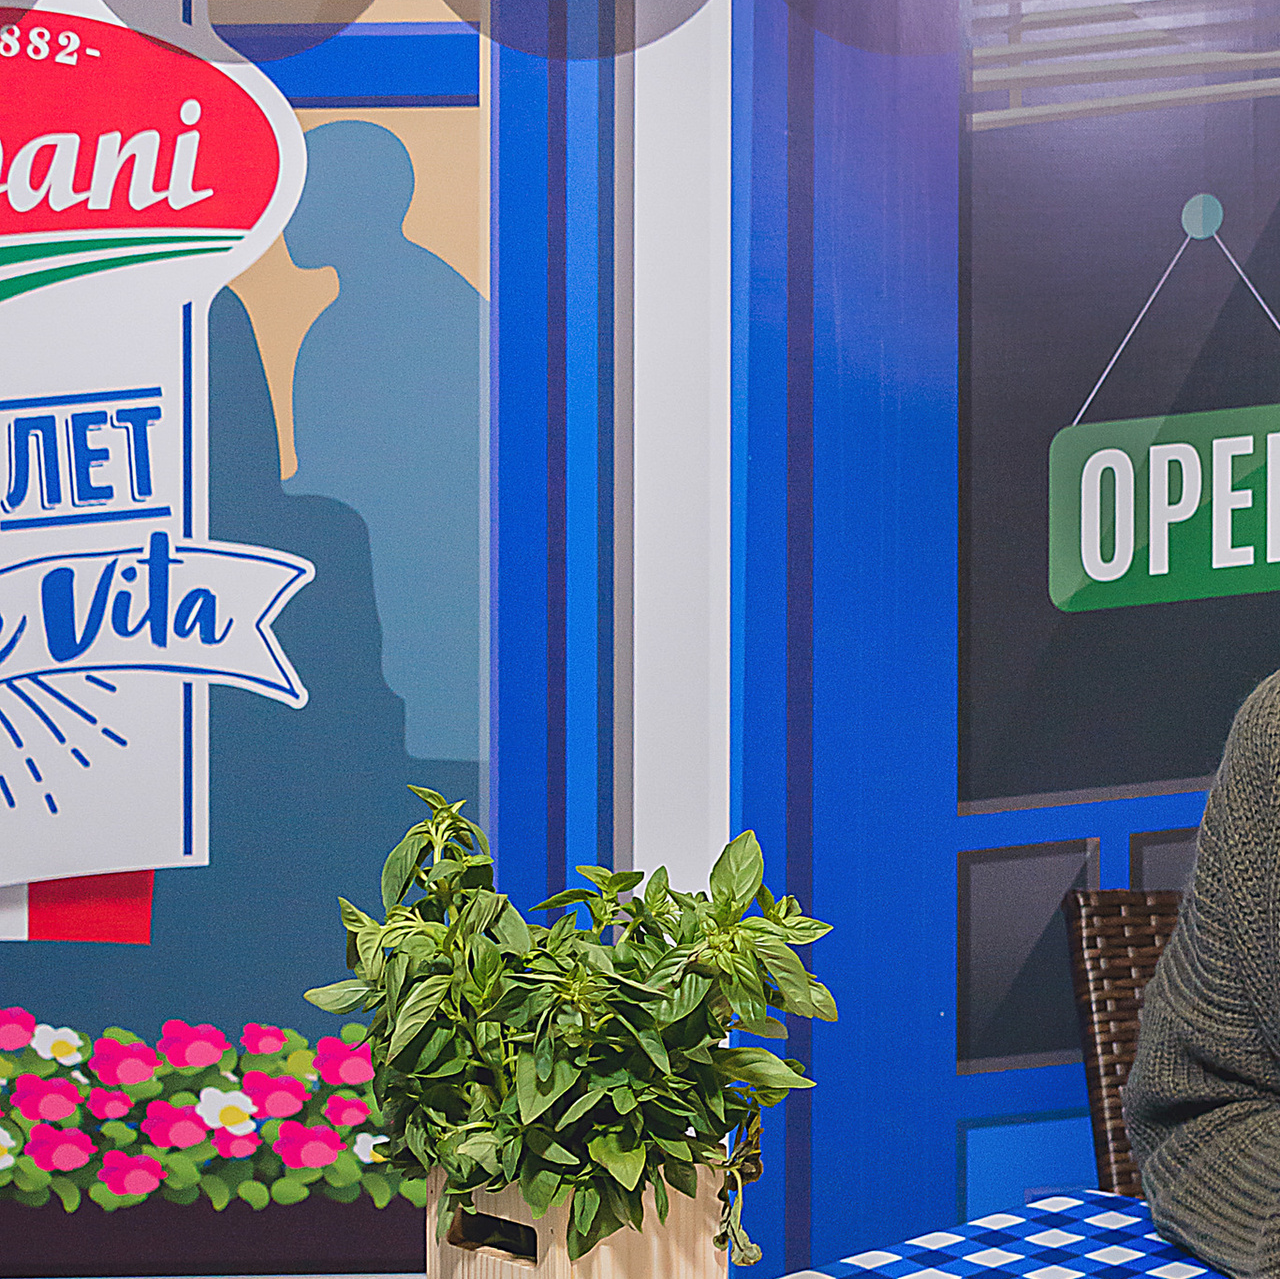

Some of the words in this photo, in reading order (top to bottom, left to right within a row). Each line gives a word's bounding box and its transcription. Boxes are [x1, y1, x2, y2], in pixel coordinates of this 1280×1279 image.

[0, 99, 214, 212] ani
[0, 406, 162, 513] ЛЕТ
[41, 531, 234, 663] Vita
